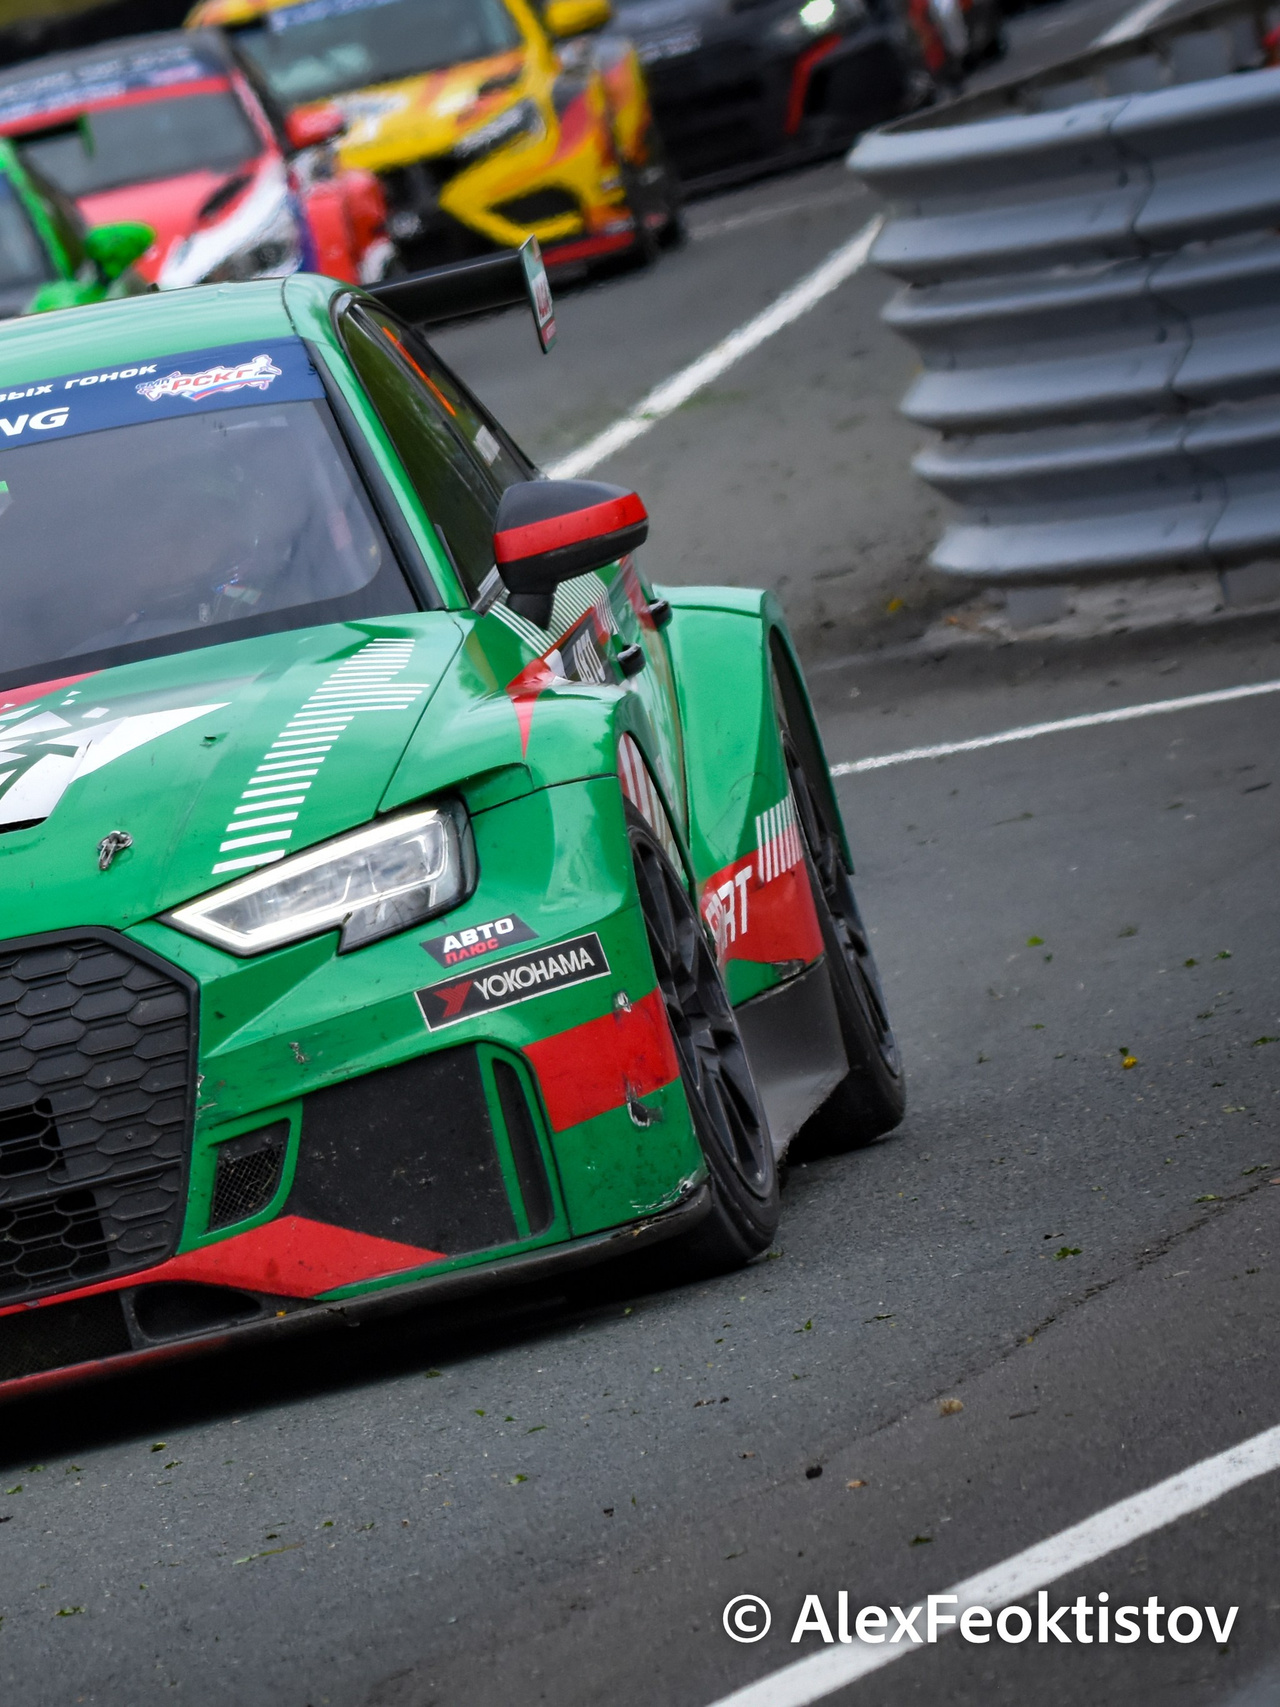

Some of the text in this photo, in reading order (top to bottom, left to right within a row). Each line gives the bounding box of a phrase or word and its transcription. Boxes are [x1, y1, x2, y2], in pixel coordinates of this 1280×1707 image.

[64, 364, 157, 389] гонок
[171, 368, 254, 391] РСКГ
[443, 917, 515, 954] АВТО
[444, 938, 500, 965] ПЛЮС
[473, 947, 596, 1000] YOKOHAMA
